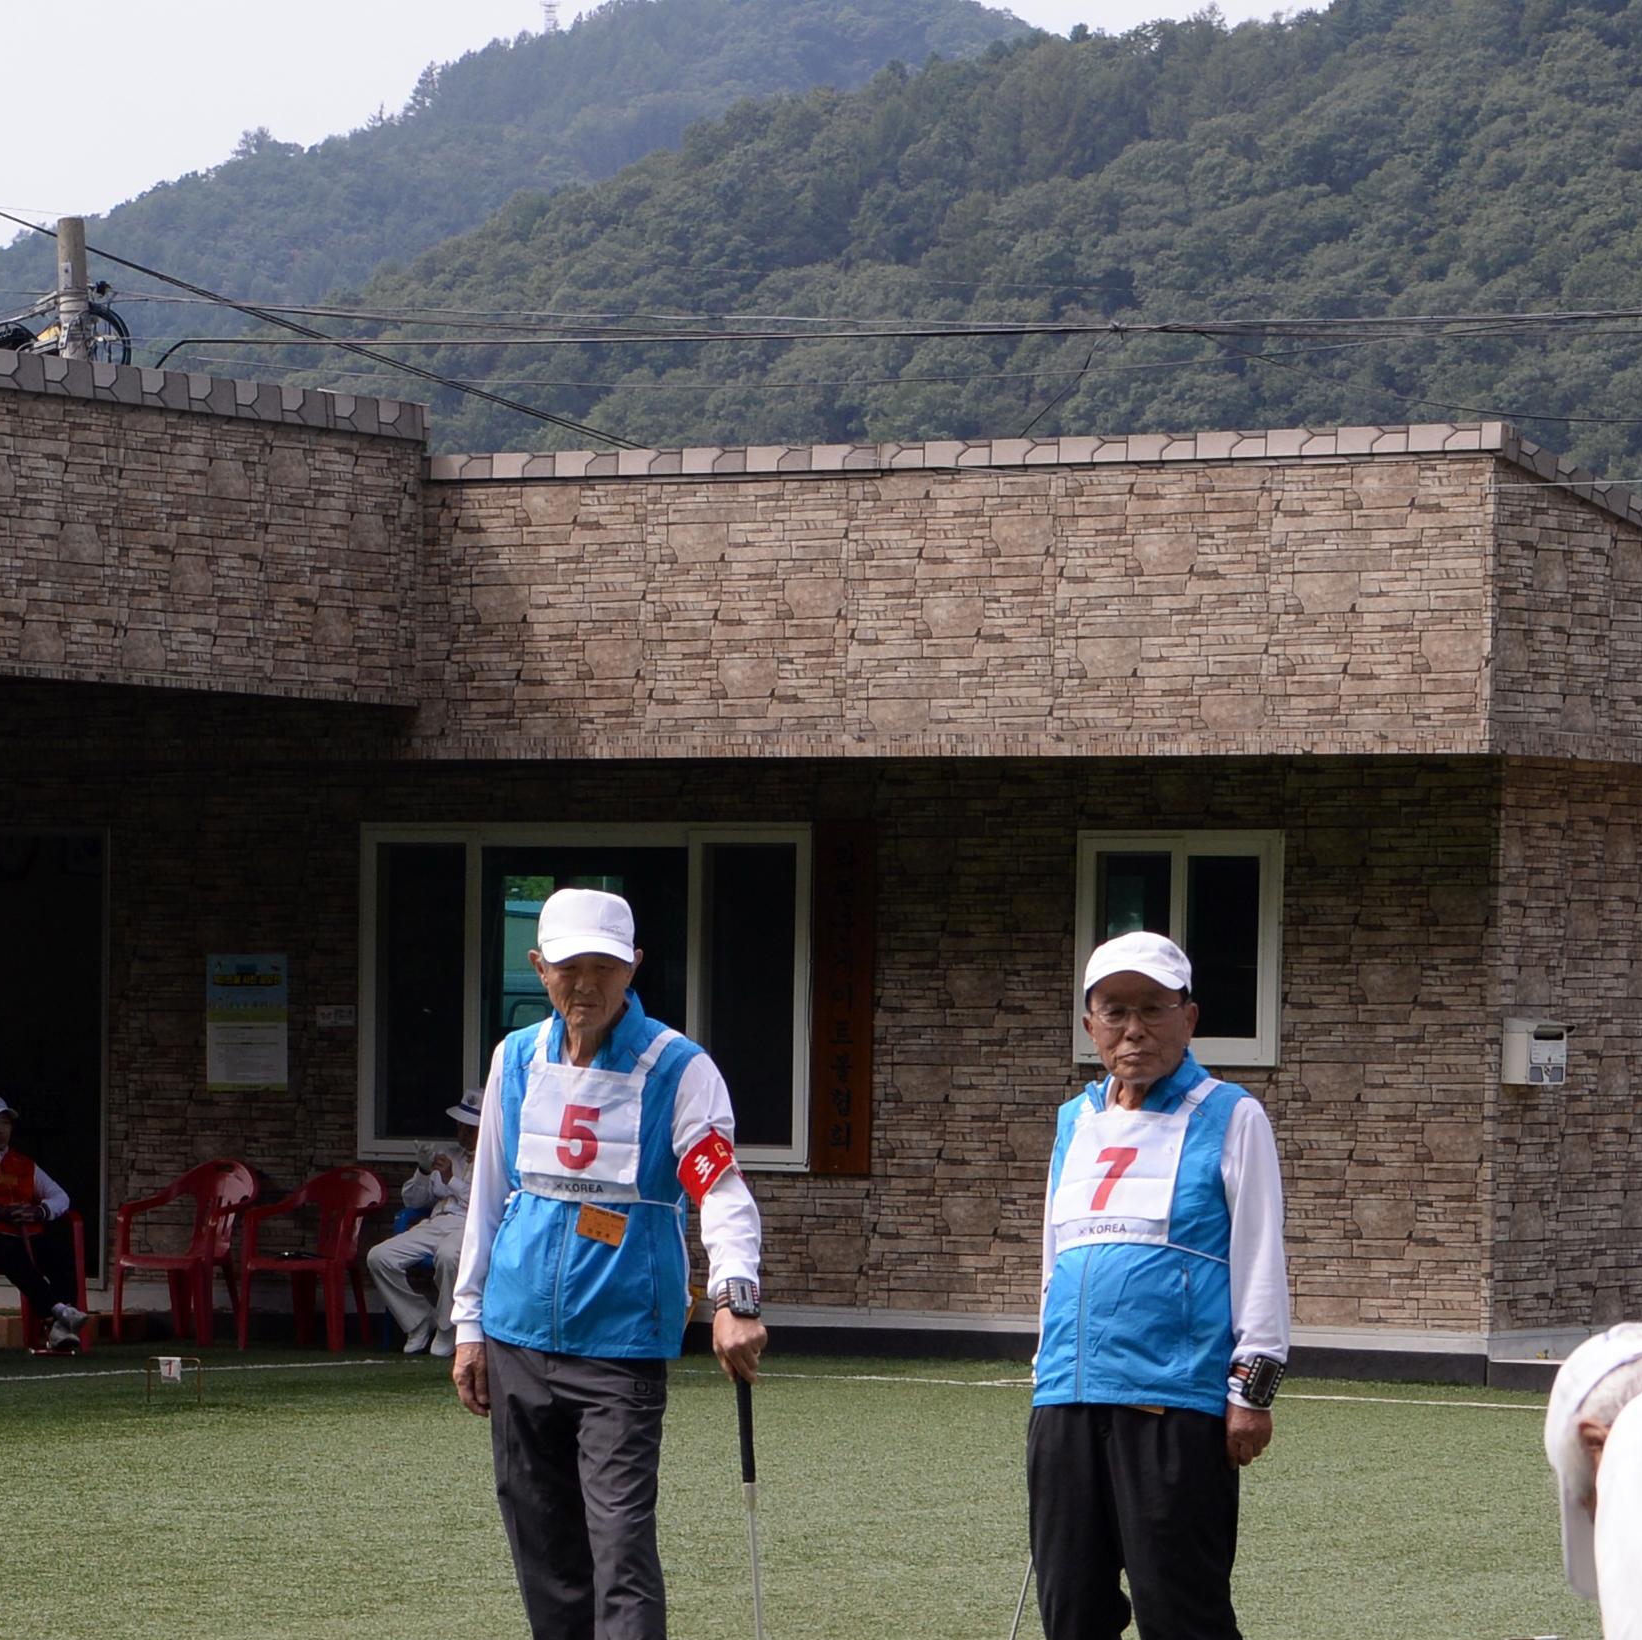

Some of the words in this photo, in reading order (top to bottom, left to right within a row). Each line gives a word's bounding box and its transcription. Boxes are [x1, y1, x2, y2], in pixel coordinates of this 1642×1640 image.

[556, 1104, 600, 1170] 5
[564, 1181, 604, 1194] KOREA
[1089, 1146, 1139, 1211] 7
[1088, 1223, 1127, 1235] KOREA
